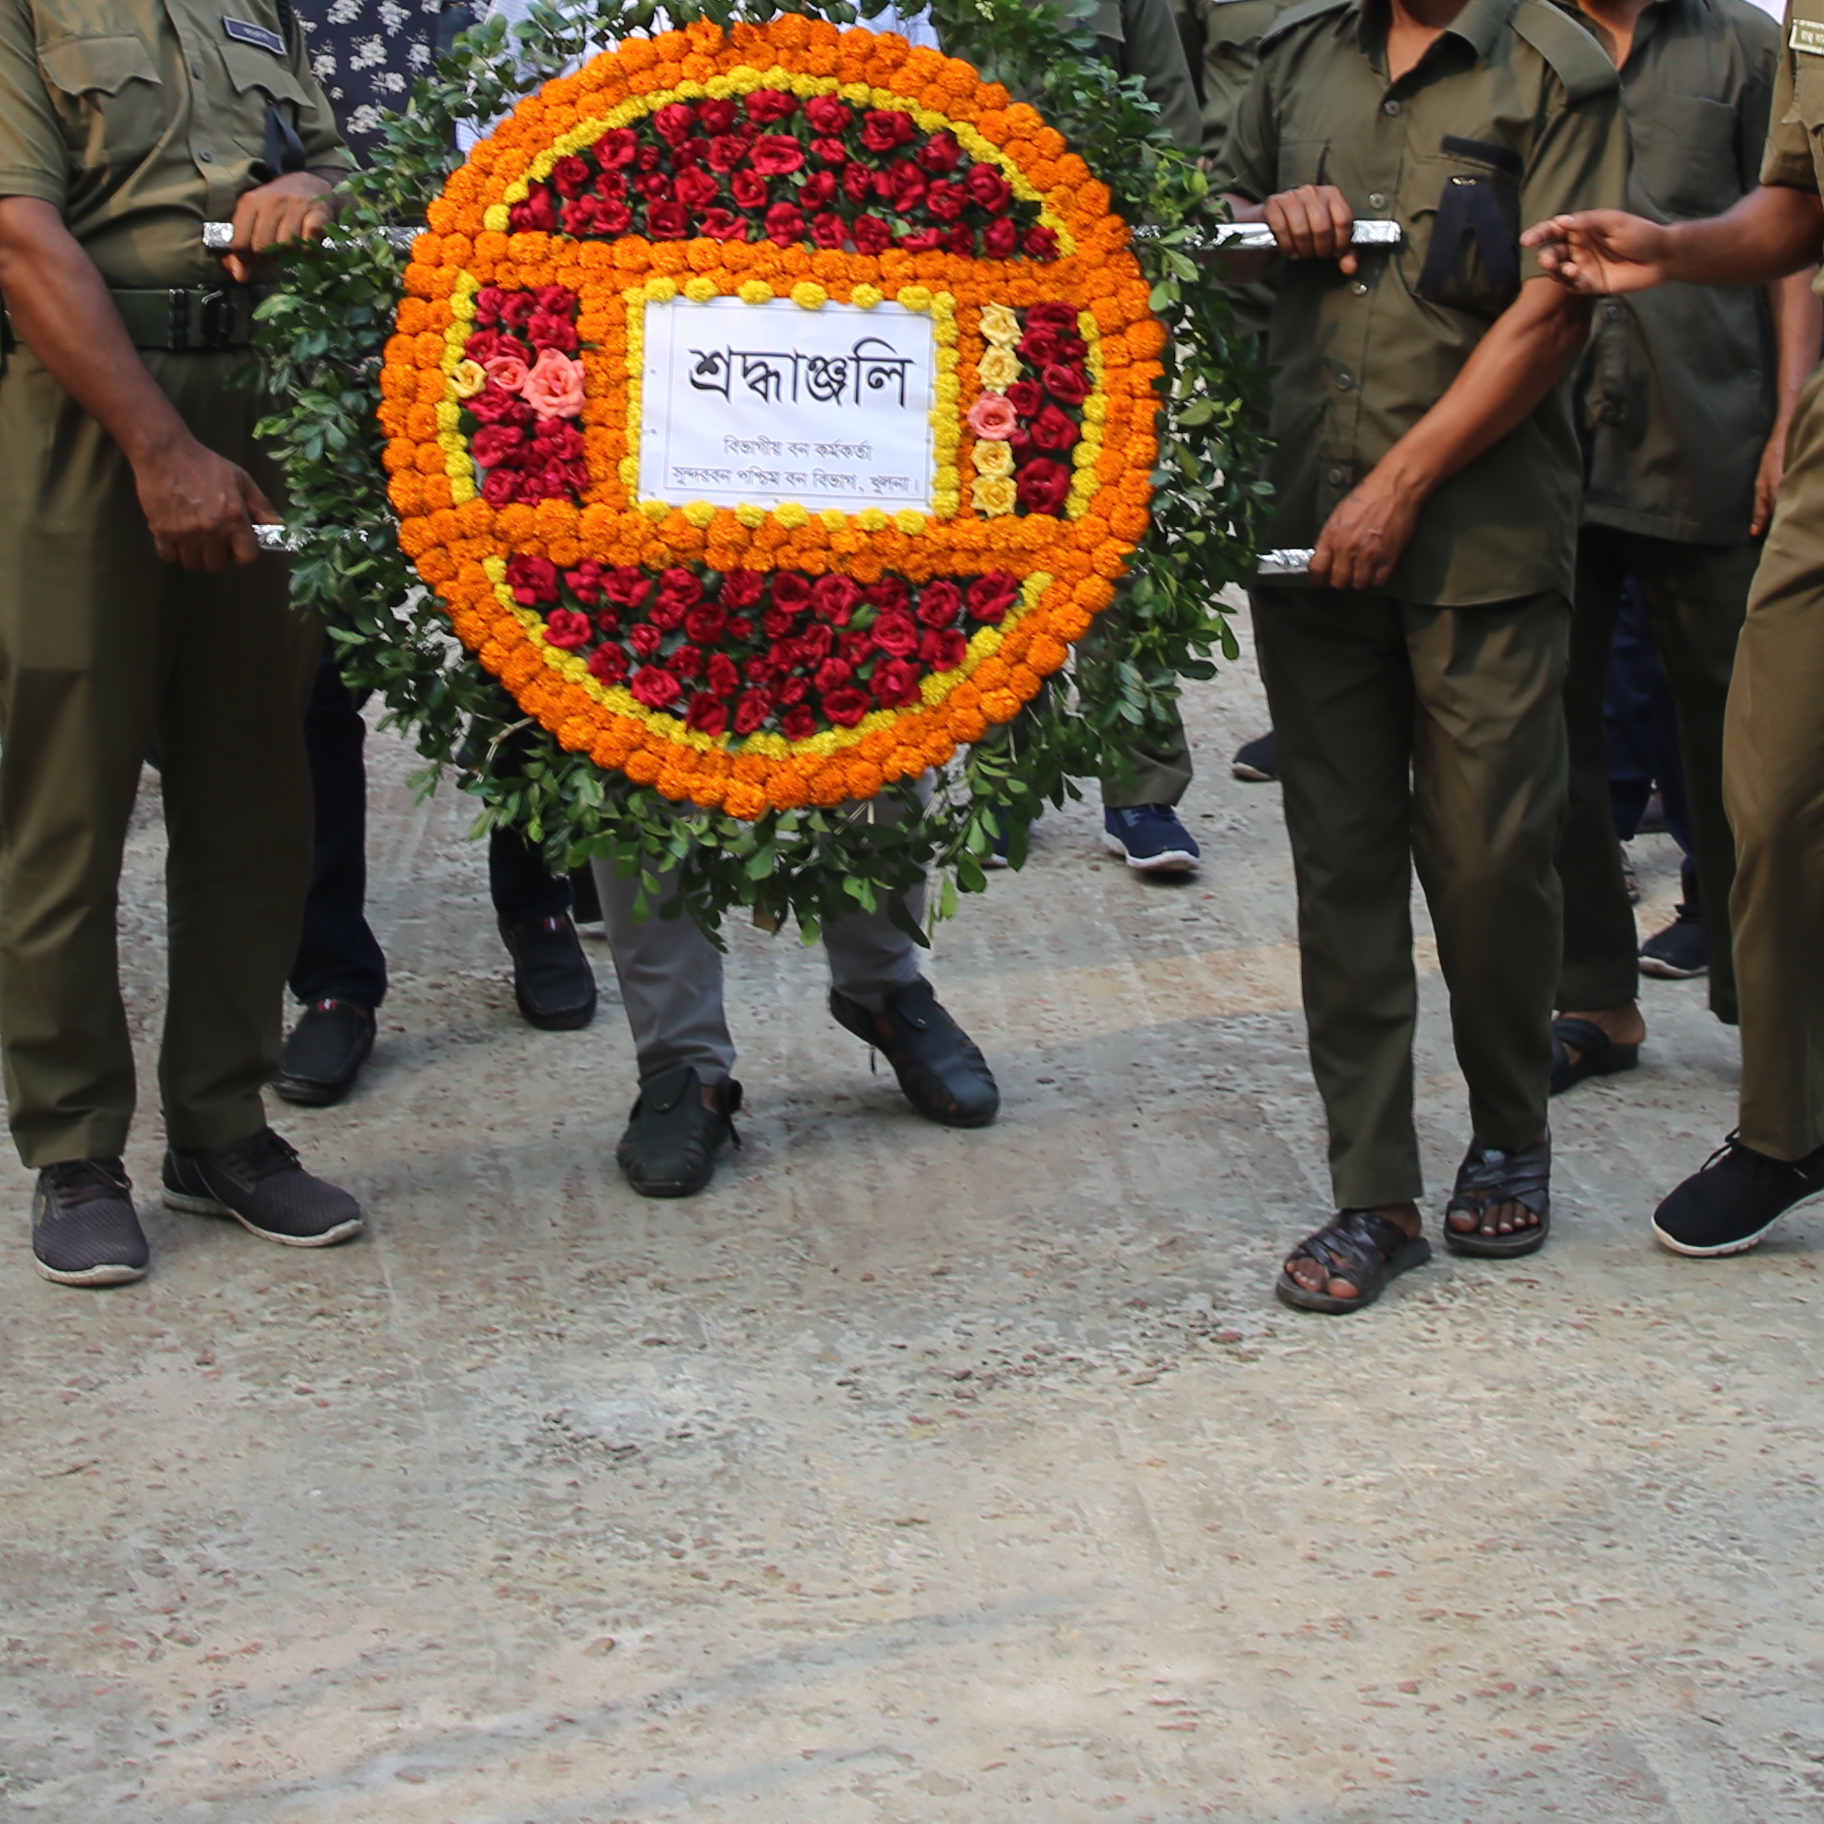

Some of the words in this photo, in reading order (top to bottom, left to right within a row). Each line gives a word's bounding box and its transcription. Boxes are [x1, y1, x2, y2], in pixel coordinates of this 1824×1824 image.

[687, 336, 916, 409] শ্রদ্ধাঞ্জলি
[723, 434, 782, 457] বিভাগীয়
[787, 441, 811, 457] বন
[814, 439, 874, 461] কর্মকর্তা
[672, 466, 731, 486] সুন্দরবন
[736, 466, 781, 487] পশ্চিম
[784, 471, 808, 488] বন
